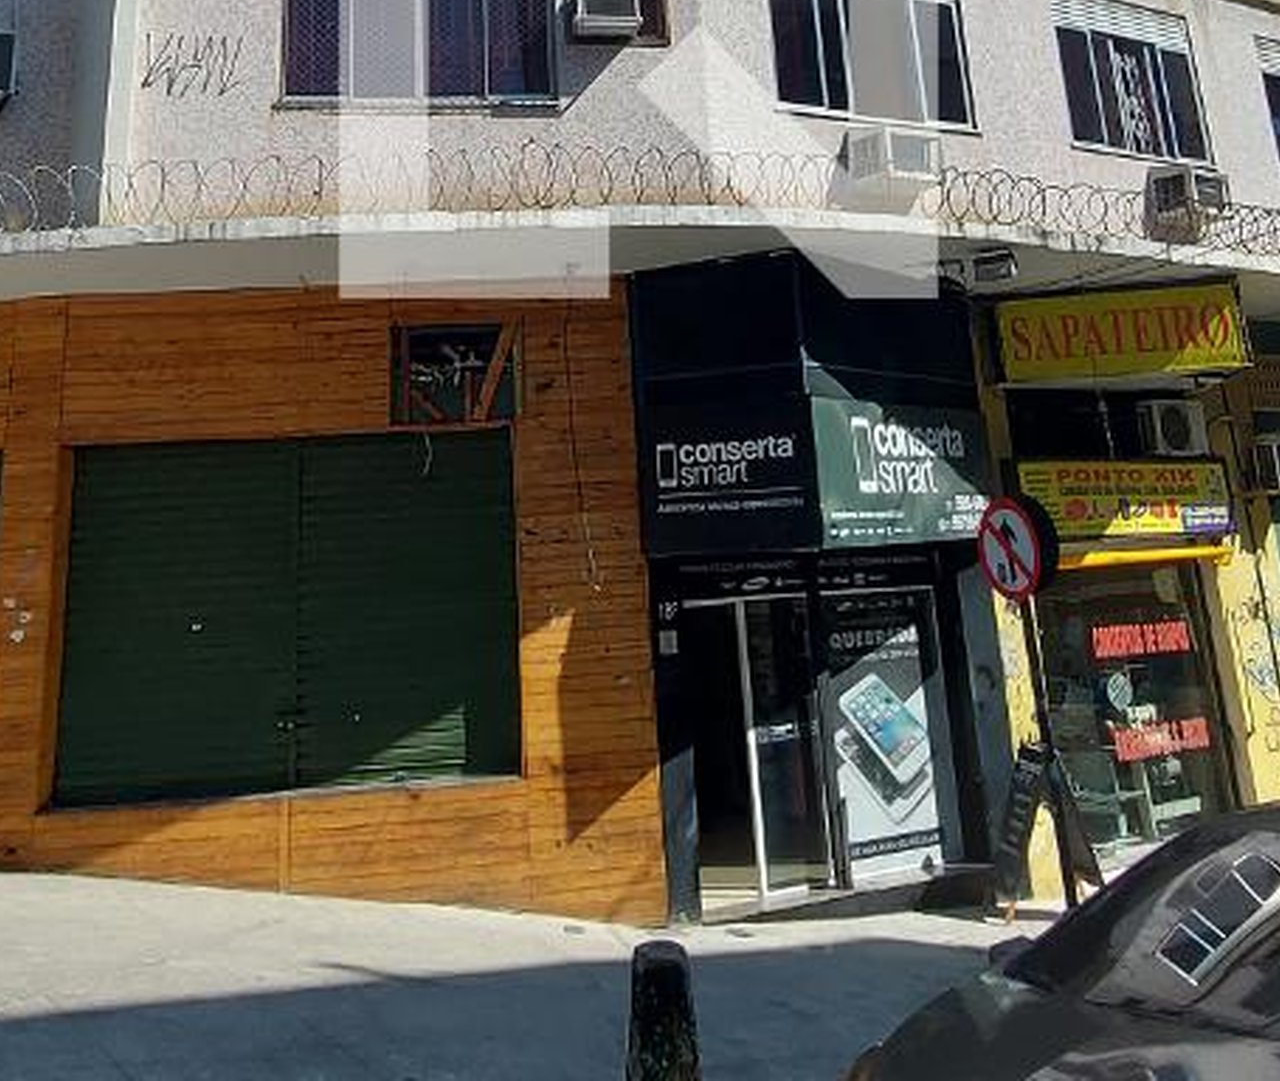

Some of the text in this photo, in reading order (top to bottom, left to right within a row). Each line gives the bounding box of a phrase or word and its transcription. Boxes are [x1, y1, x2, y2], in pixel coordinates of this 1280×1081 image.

[1010, 302, 1231, 361] SAPATEIRO
[679, 435, 793, 464] conserta
[873, 421, 966, 458] conserta
[681, 460, 748, 488] smart
[878, 458, 940, 494] smart
[1055, 468, 1146, 485] PONTO
